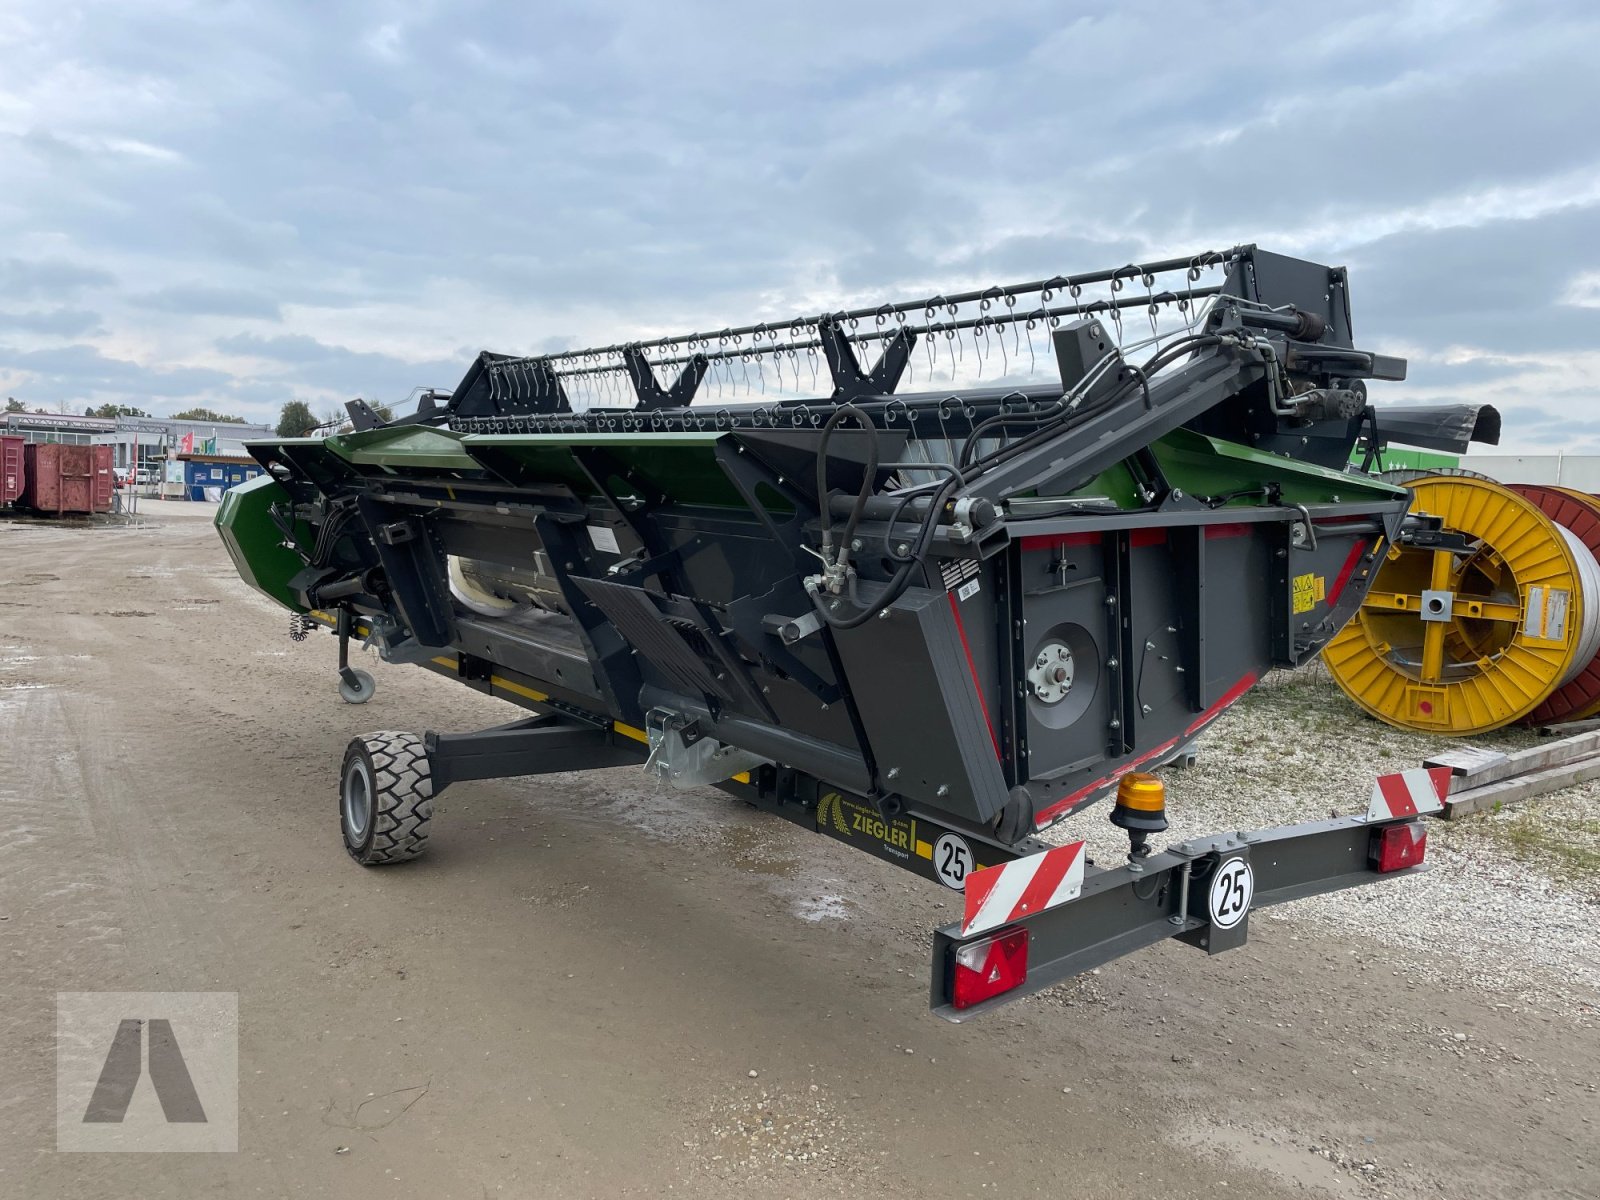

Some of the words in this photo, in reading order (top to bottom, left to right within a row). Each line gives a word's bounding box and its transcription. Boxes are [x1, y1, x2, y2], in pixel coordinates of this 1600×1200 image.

[852, 812, 908, 850] ZIEGLER
[941, 841, 966, 882] 25
[1217, 869, 1247, 917] 25
